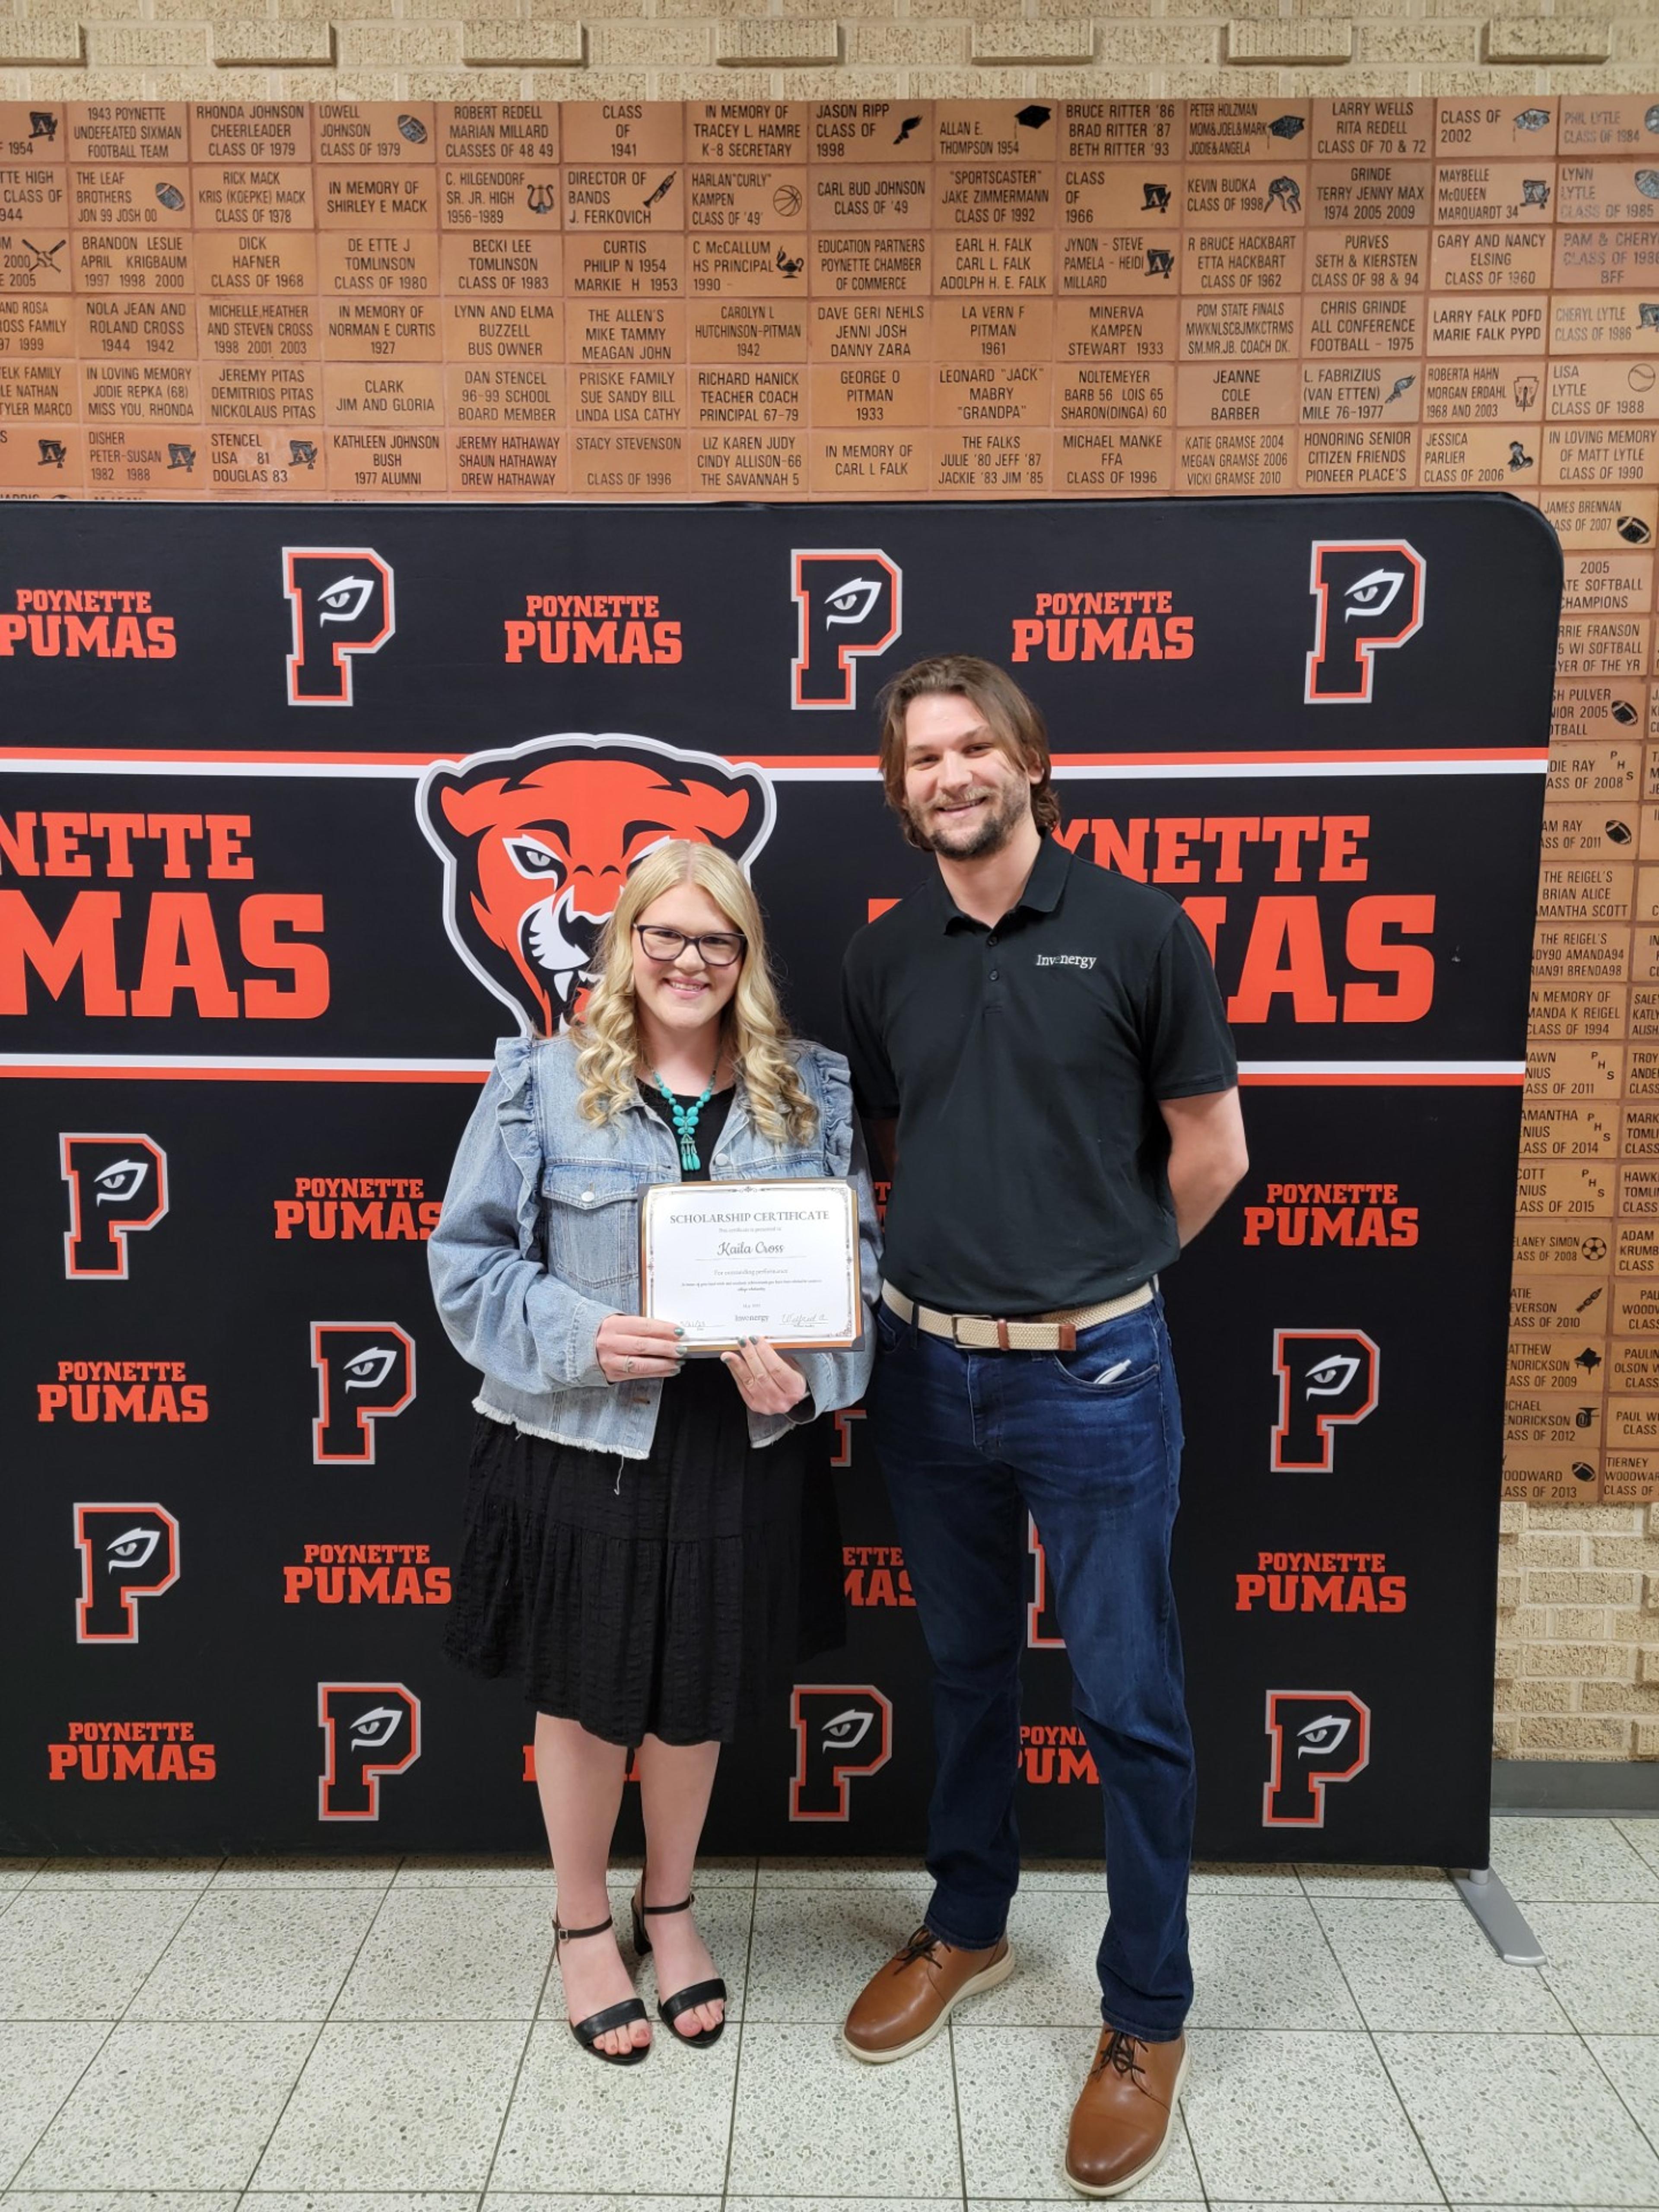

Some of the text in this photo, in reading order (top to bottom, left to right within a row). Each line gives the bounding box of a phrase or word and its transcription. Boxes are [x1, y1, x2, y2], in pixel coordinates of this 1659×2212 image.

[88, 107, 165, 121] 1943 POYNETTE
[816, 103, 890, 118] JASON RIPP
[1066, 104, 1174, 118] BRUCE RITTER '86
[1441, 109, 1501, 124] CLASS OF
[73, 125, 181, 140] UNDEFEATED SIXMAN
[816, 123, 876, 138] CLASS OF
[1069, 123, 1171, 137] BRAD RITTER '87
[1441, 128, 1471, 143] 2002
[88, 144, 168, 158] FOOTBALL TEAM
[817, 142, 845, 157] 1998
[1069, 142, 1169, 156] BETH RITTER '93
[568, 171, 646, 186] DIRECTOR OF
[1065, 171, 1105, 185] CLASS
[329, 181, 419, 195] IN MEMORY OF
[569, 191, 610, 204] BANDS
[1065, 190, 1080, 204] OF
[327, 199, 427, 213] SHIRLEY E MACK
[569, 209, 652, 224] J. FERKOVICH
[1065, 209, 1093, 223] 1966
[818, 238, 925, 254] EDUCATION PARTNERS
[821, 257, 921, 272] POYNETTE CHAMBER
[836, 276, 906, 291] OF COMMERCE
[1090, 306, 1144, 319] MINERVA
[1433, 308, 1542, 324] LARRY FALK PDFD
[1091, 324, 1142, 337] KAMPEN
[1433, 327, 1541, 341] MARIE FALK PYPD
[1068, 342, 1163, 356] STEWART 1933
[219, 369, 305, 383] JEREMY PITAS
[699, 372, 799, 385] RICHARD HANICK
[1213, 369, 1260, 384] JEANNE
[1553, 365, 1579, 378] LISA
[211, 386, 314, 400] DEMITRIOS PITAS
[700, 390, 798, 404] TEACHER COACH
[1222, 388, 1250, 402] COLE
[1553, 383, 1586, 397] LYTLE
[211, 404, 316, 419] NICKOLAUS PITAS
[700, 408, 799, 422] PRINCIPAL 67-79
[1211, 406, 1259, 421] BARBER
[1551, 400, 1644, 416] CLASS OF 1988
[456, 436, 560, 450] JEREMY HATHAWAY
[1063, 435, 1162, 448] MICHAEL MANKE
[1304, 431, 1411, 446] HONORING SENIOR
[459, 454, 557, 468] SHAUN HATHAWAY
[1101, 452, 1122, 466] FFA
[1308, 449, 1406, 464] CITIZEN FRIENDS
[461, 473, 556, 486] DREW HATHAWAY
[1067, 471, 1157, 484] CLASS OF 1996
[1306, 467, 1406, 483] PIONEER PLACE'S
[1544, 500, 1621, 514] JAMES BRENNAN
[1580, 561, 1610, 574] 2005
[17, 589, 151, 613] POYNETTE
[526, 595, 659, 618] POYNETTE
[1036, 591, 1172, 615] POYNETTE
[282, 546, 396, 706] P
[791, 548, 903, 710] P
[1304, 539, 1427, 704] P
[0, 614, 176, 658] PUMAS
[505, 620, 683, 664] PUMAS
[1011, 616, 1194, 662] PUMAS
[0, 811, 254, 880] NETTE
[1545, 871, 1613, 883] THE REIGEL'S
[1542, 887, 1611, 900] BRIAN ALICE
[1541, 933, 1607, 945] THE REIGEL'S
[0, 889, 330, 1019] MAS
[1035, 954, 1098, 969] Invenergy
[1527, 1023, 1609, 1035] CLASS OF 1994
[295, 1177, 424, 1199] POYNETTE
[1267, 1184, 1398, 1204] POYNETTE
[59, 1132, 169, 1280] P
[670, 1210, 830, 1224] SCHOLARSHIP CERTIFICATE
[1243, 1207, 1419, 1247] PUMAS
[1513, 1236, 1580, 1247] ELANEY SIMON
[1621, 1230, 1654, 1241] ADAM
[717, 1241, 785, 1255] Kaila Cross
[1509, 1343, 1551, 1355] ATTHEW
[58, 1361, 186, 1382] POYNETTE
[310, 1321, 416, 1465] P
[1271, 1328, 1380, 1472] P
[37, 1384, 209, 1423] PUMAS
[1607, 1457, 1649, 1468] TIERNEY
[304, 1544, 430, 1564] POYNETTE
[842, 1547, 904, 1566] ETTE
[1258, 1552, 1386, 1573] POYNETTE
[73, 1503, 180, 1643] P
[283, 1566, 452, 1605] PUMAS
[1235, 1574, 1407, 1613] PUMAS
[68, 1721, 194, 1742] POYNETTE
[1020, 1726, 1087, 1746] POYN
[318, 1682, 421, 1821] P
[789, 1684, 892, 1821] P
[1263, 1690, 1370, 1827] P
[48, 1743, 216, 1781] PUMAS
